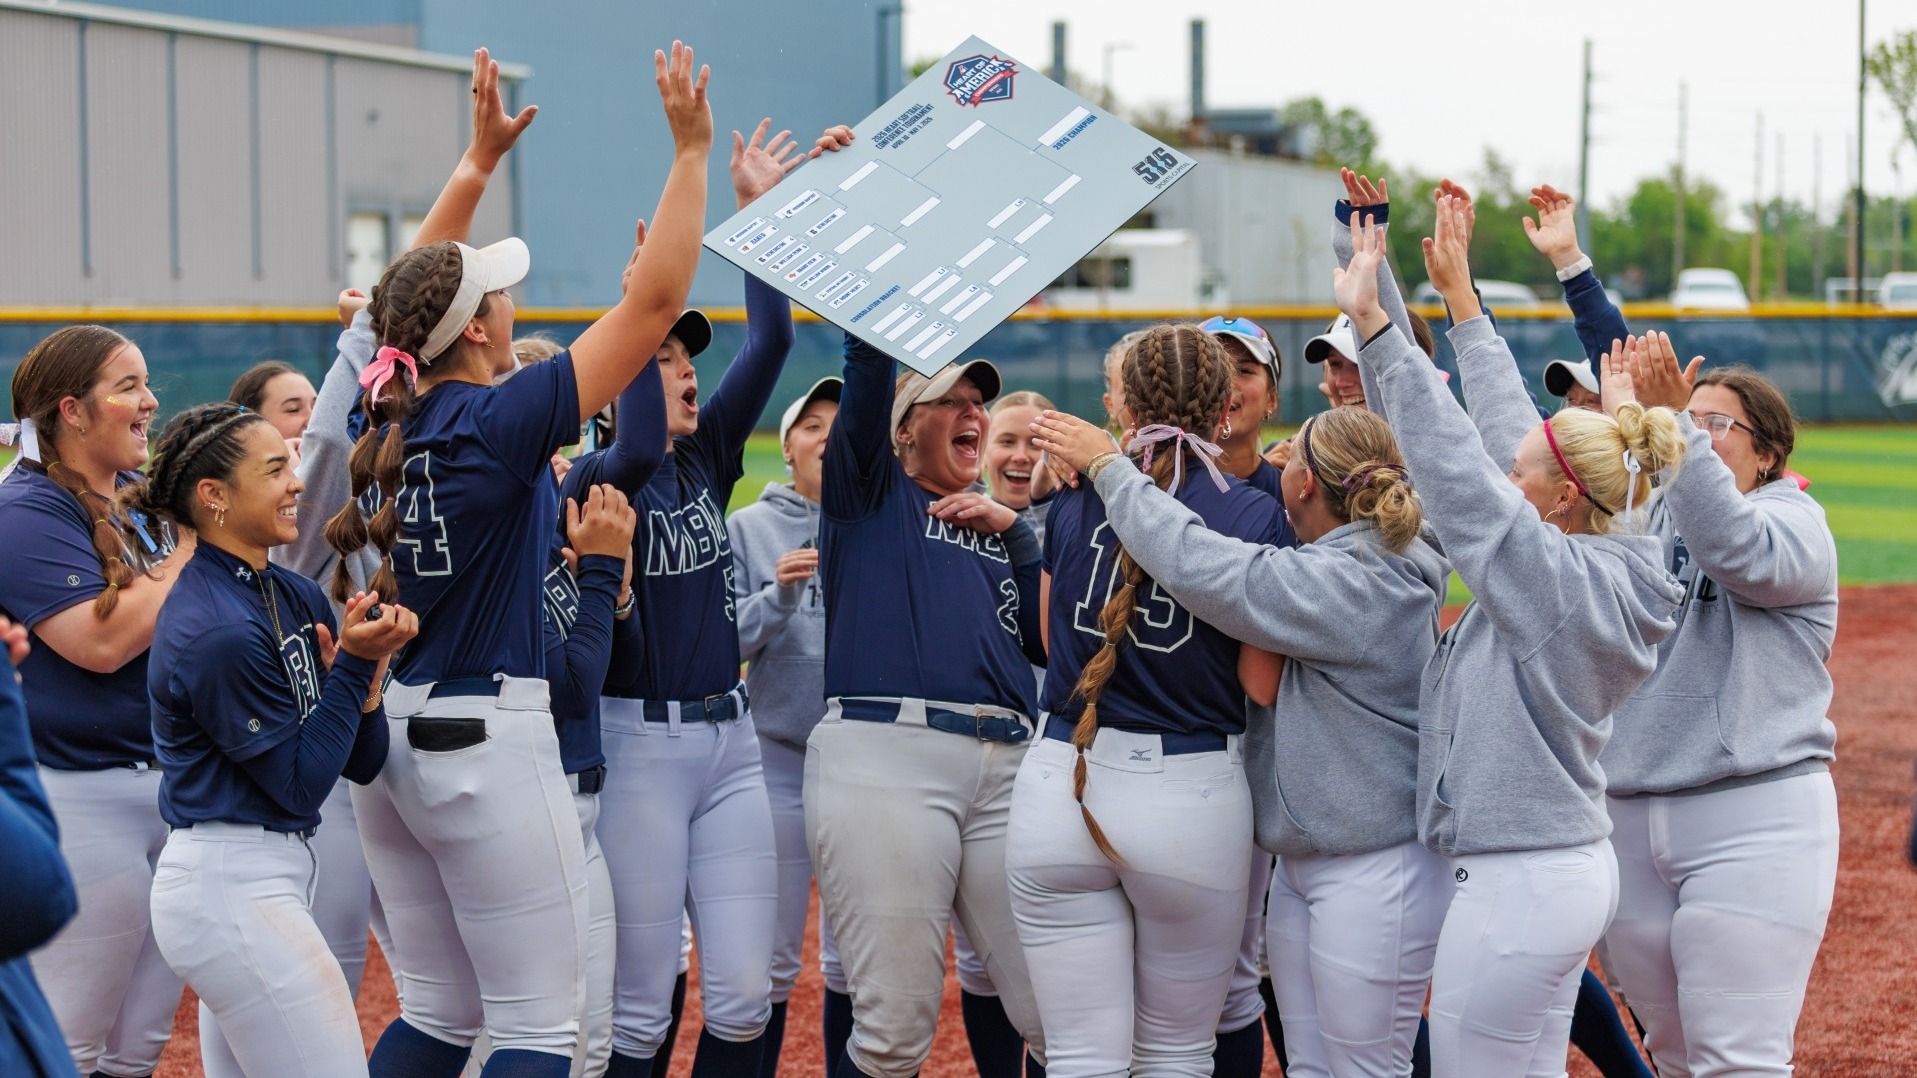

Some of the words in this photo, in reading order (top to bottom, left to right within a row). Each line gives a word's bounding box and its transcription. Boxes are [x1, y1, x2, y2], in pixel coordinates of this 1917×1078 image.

[951, 58, 1014, 105] AMERICA
[952, 68, 979, 88] HEART
[974, 60, 988, 70] OF
[871, 131, 888, 143] 2026
[883, 120, 902, 133] HEART
[897, 103, 924, 122] SOFTBALL
[875, 126, 907, 150] CONFERENCE
[901, 104, 935, 129] TOURNAMENT
[908, 127, 920, 136] MAY
[1052, 137, 1071, 150] 2026
[1067, 115, 1098, 138] CHAMPION
[1132, 147, 1179, 186] 516
[1154, 175, 1174, 190] SPORTS
[1171, 162, 1191, 177] CAPITAL
[850, 299, 882, 323] CONSOLATION
[879, 285, 901, 301] BRACKET
